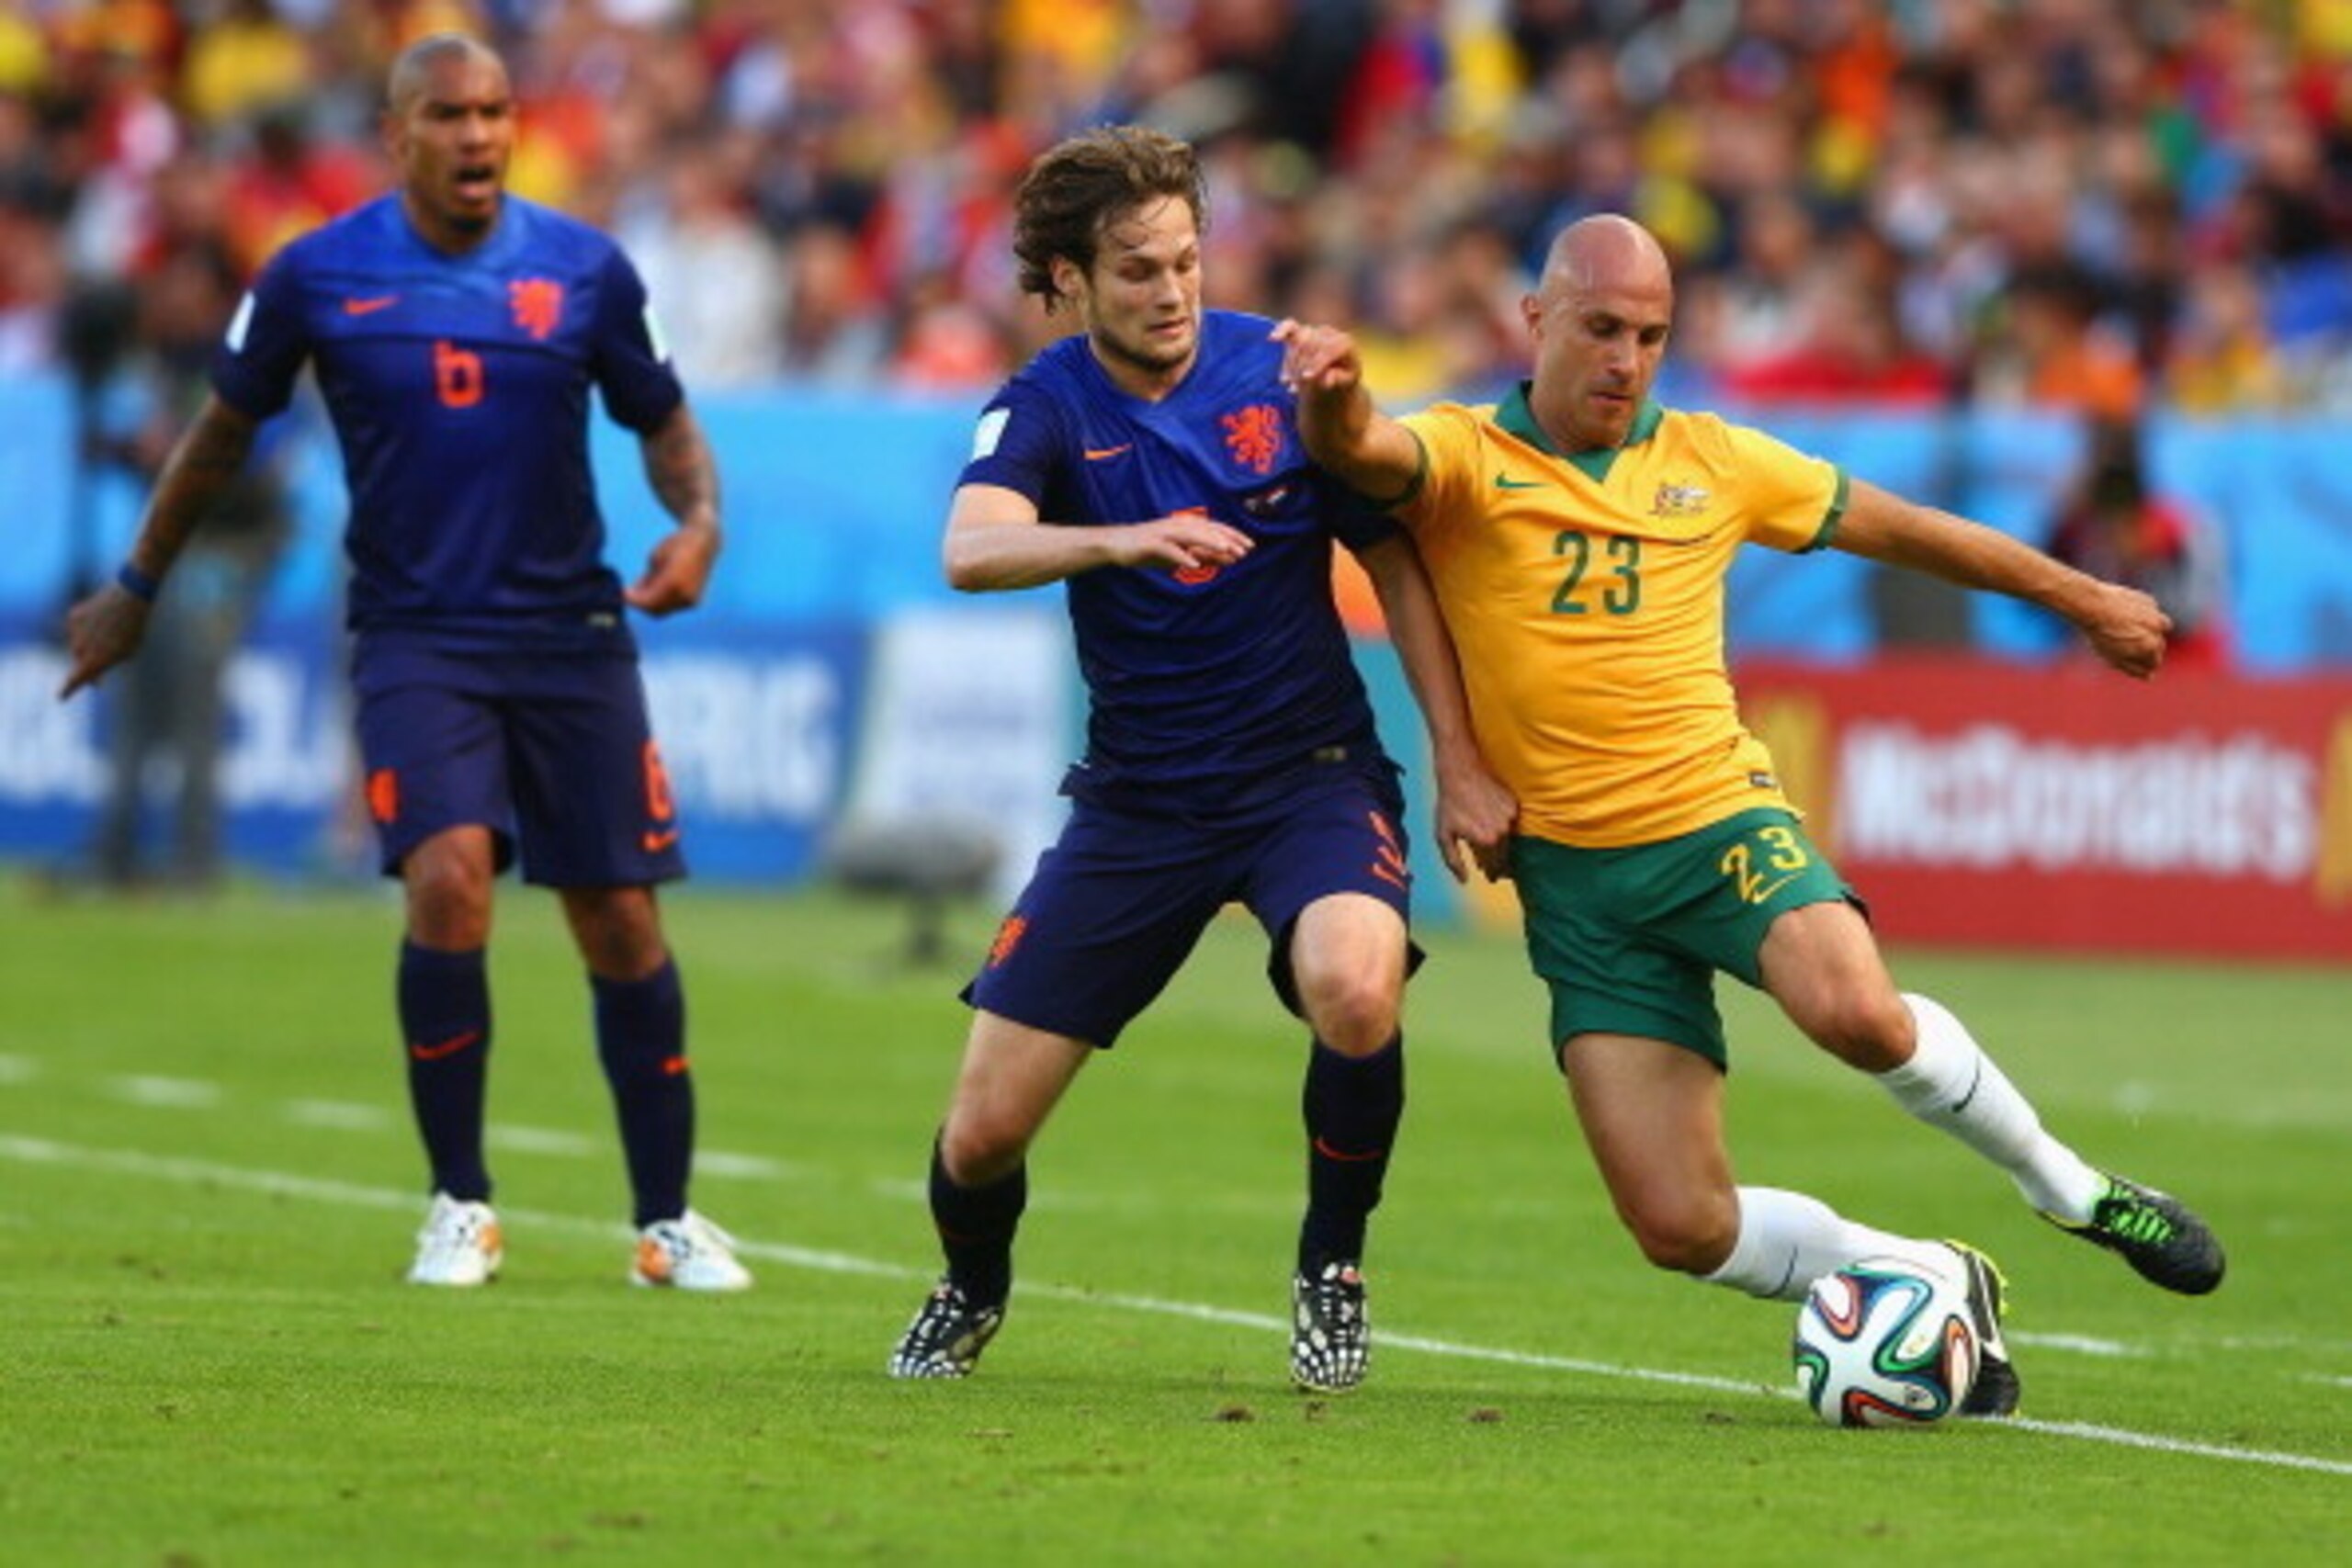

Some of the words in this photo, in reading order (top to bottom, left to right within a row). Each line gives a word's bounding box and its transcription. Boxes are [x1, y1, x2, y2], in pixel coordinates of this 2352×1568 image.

[435, 340, 483, 408] 6
[1550, 529, 1642, 615] 23
[1840, 721, 2313, 880] McDonald's
[1720, 826, 1808, 903] 23
